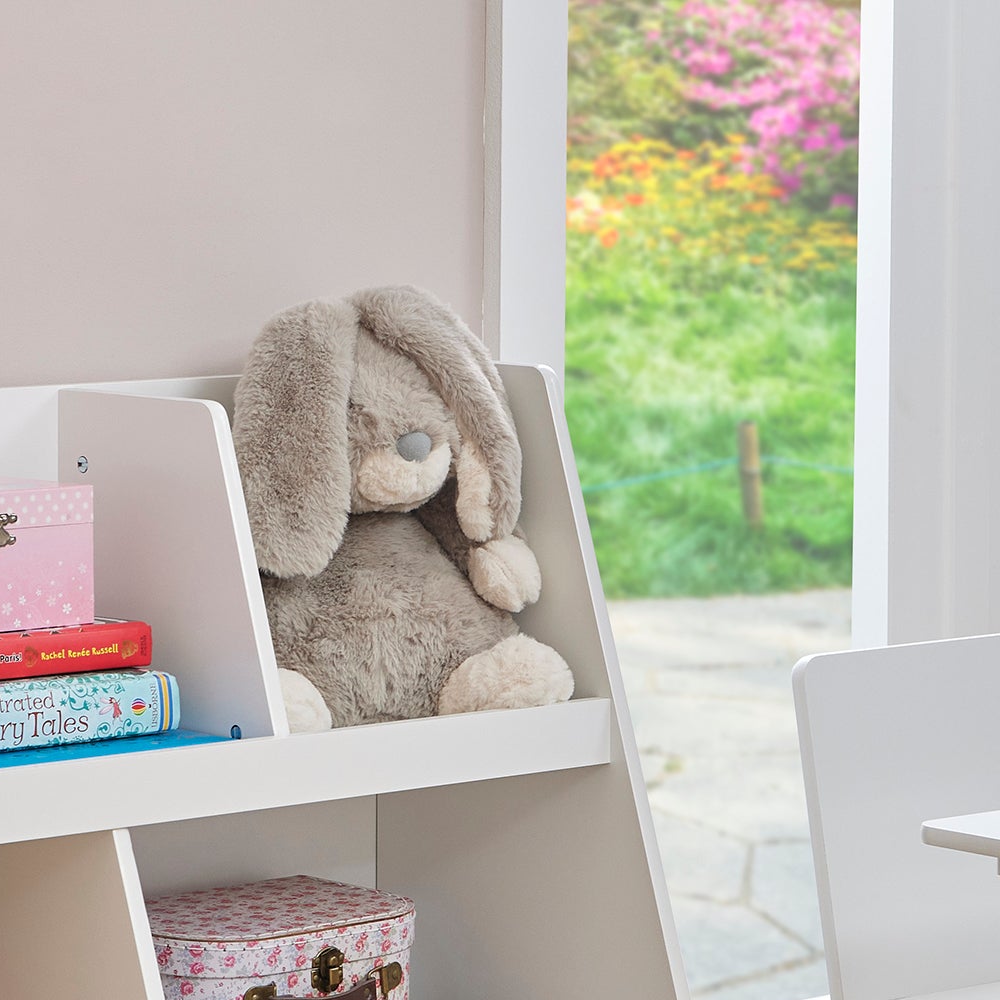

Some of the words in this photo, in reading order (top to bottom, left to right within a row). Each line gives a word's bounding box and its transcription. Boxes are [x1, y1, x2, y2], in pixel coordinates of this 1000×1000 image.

[0, 651, 23, 664] Paris!
[41, 649, 66, 661] Rachel
[68, 648, 90, 658] Renée
[92, 644, 119, 655] Russell
[28, 710, 90, 737] Tales
